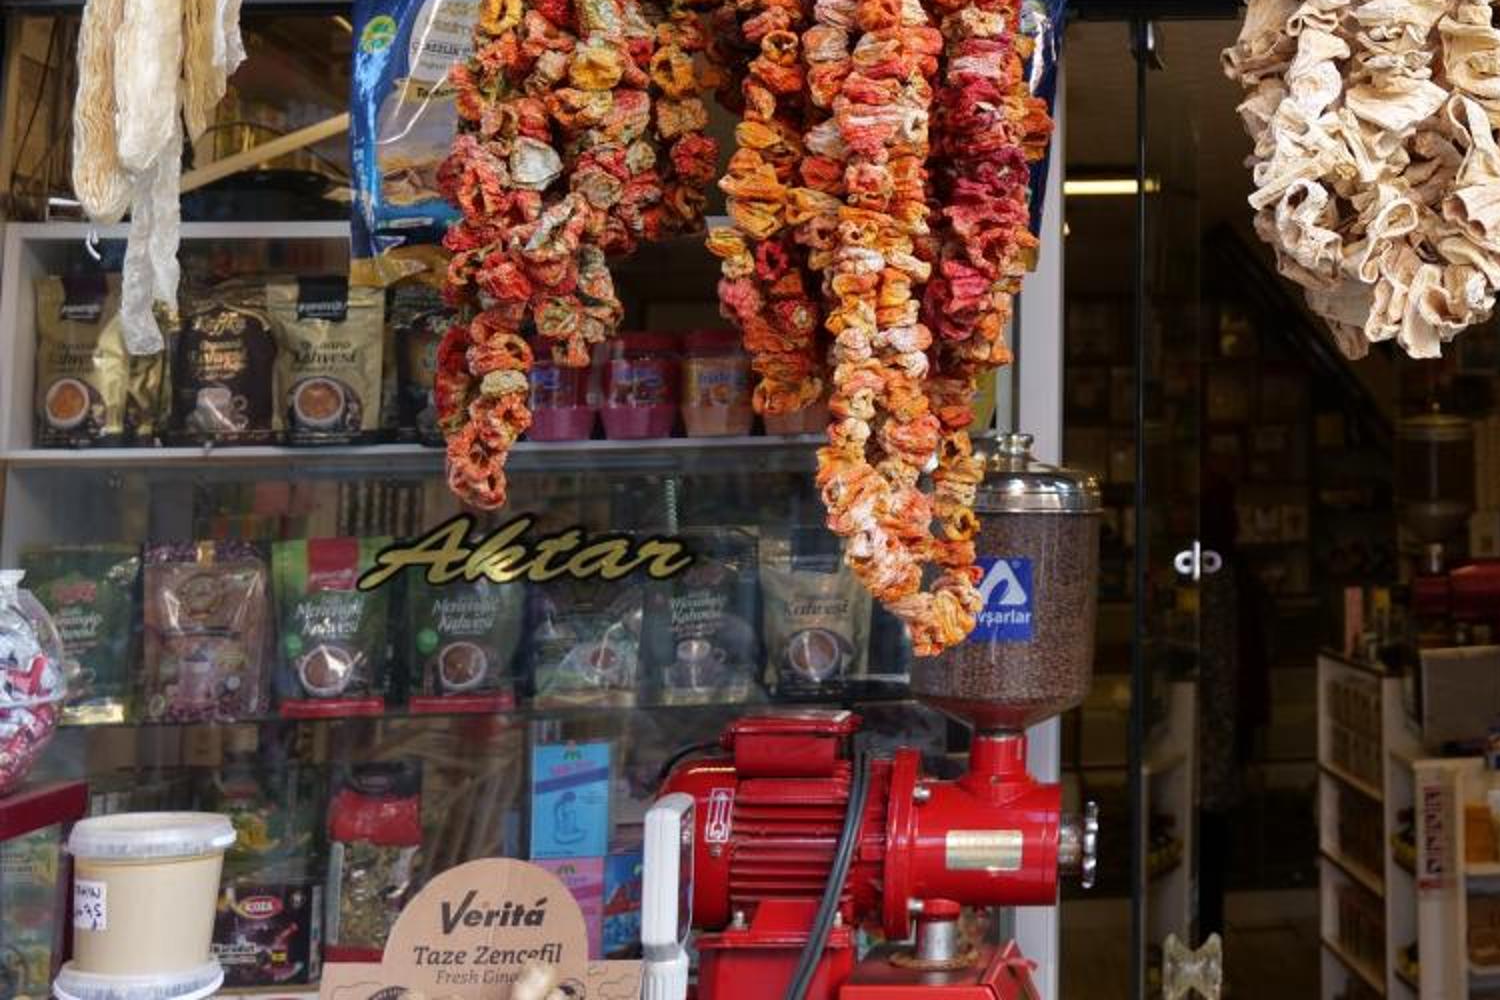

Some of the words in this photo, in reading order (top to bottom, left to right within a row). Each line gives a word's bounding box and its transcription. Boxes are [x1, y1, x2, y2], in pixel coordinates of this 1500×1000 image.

[358, 515, 692, 592] Aktar
[976, 608, 1032, 627] vşarlar
[441, 889, 549, 935] Veritá
[413, 945, 468, 966] Taze
[473, 943, 563, 966] Zencefil
[435, 969, 480, 985] Fresh
